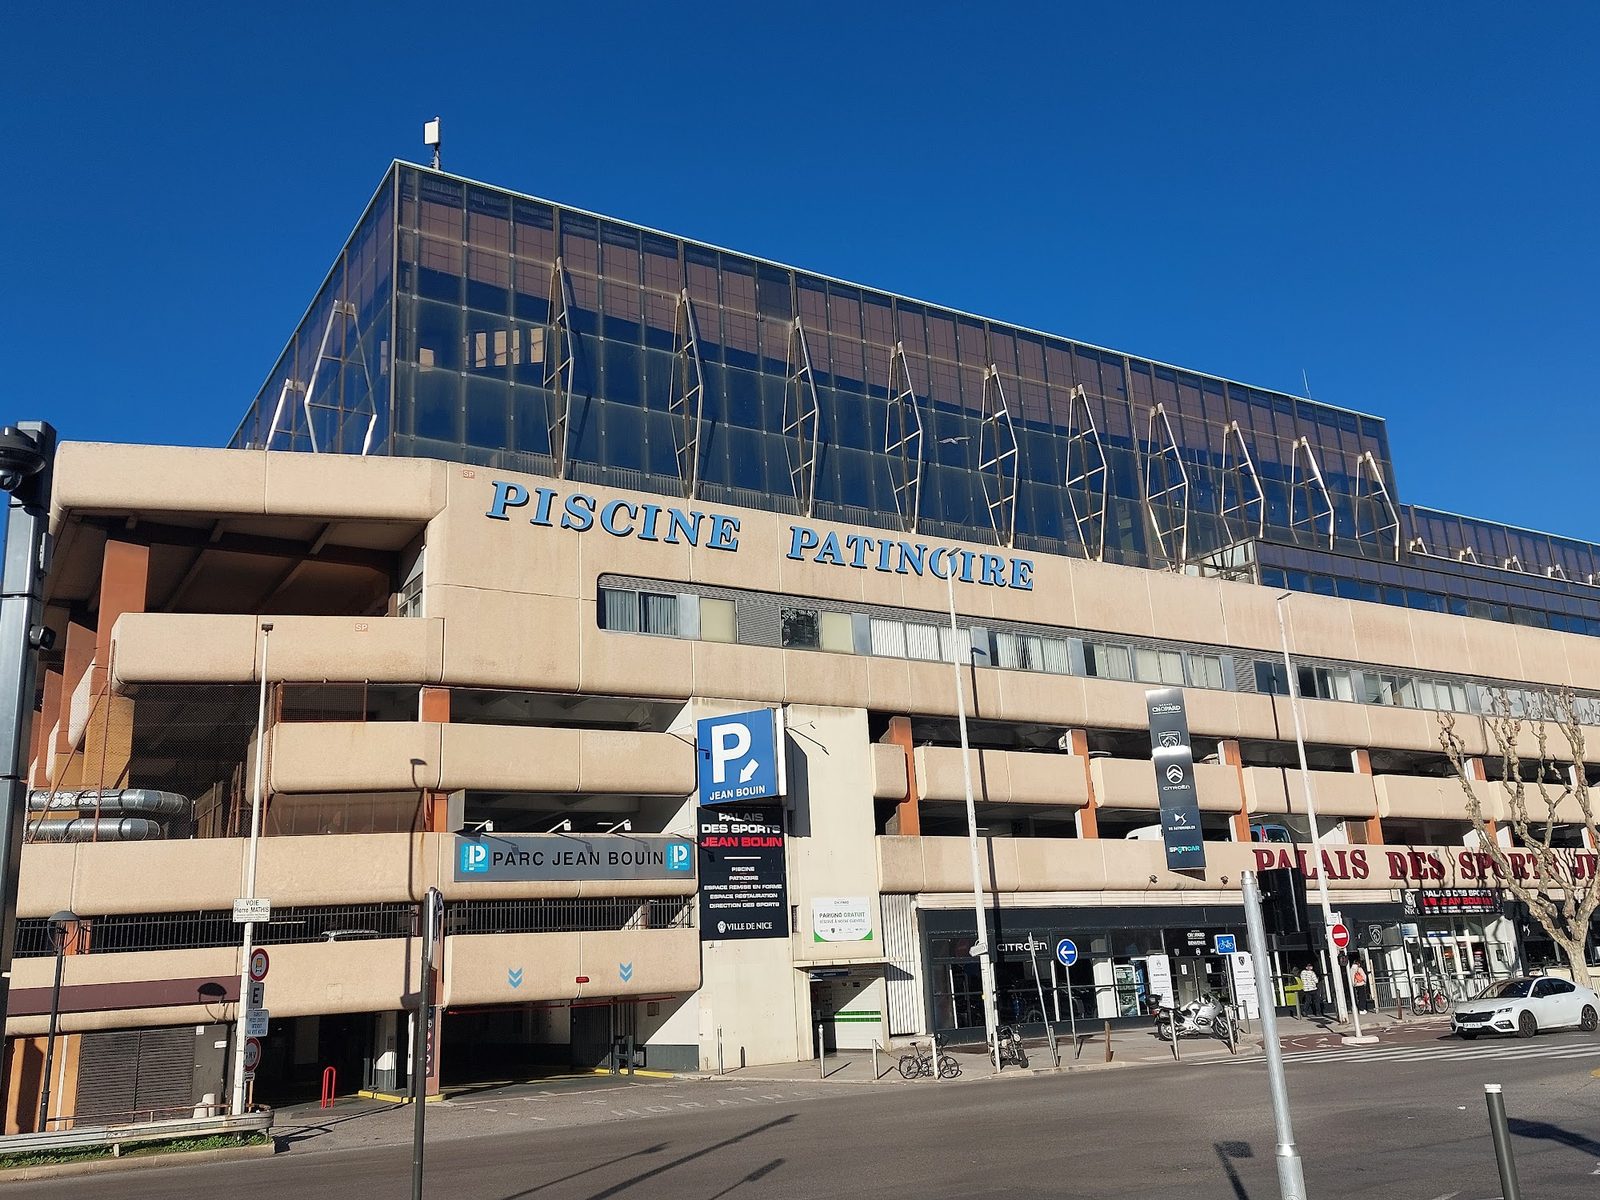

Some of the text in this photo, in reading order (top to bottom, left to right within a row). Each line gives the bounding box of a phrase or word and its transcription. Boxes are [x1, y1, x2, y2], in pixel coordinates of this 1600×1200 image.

[485, 480, 1034, 591] PISCINE PATINOIRE
[711, 723, 751, 783] P
[709, 785, 766, 801] JEAN BOUIN
[718, 812, 764, 822] PALAIS
[701, 824, 780, 833] DES SPORTS
[701, 836, 783, 847] JEAN BOUIN
[492, 851, 545, 866] PARC
[552, 851, 600, 866] JEAN
[608, 851, 664, 866] BOUIN
[1252, 849, 1370, 880] PALAIS
[1385, 850, 1446, 880] DES
[756, 922, 773, 930] NICE
[252, 987, 260, 1003] E
